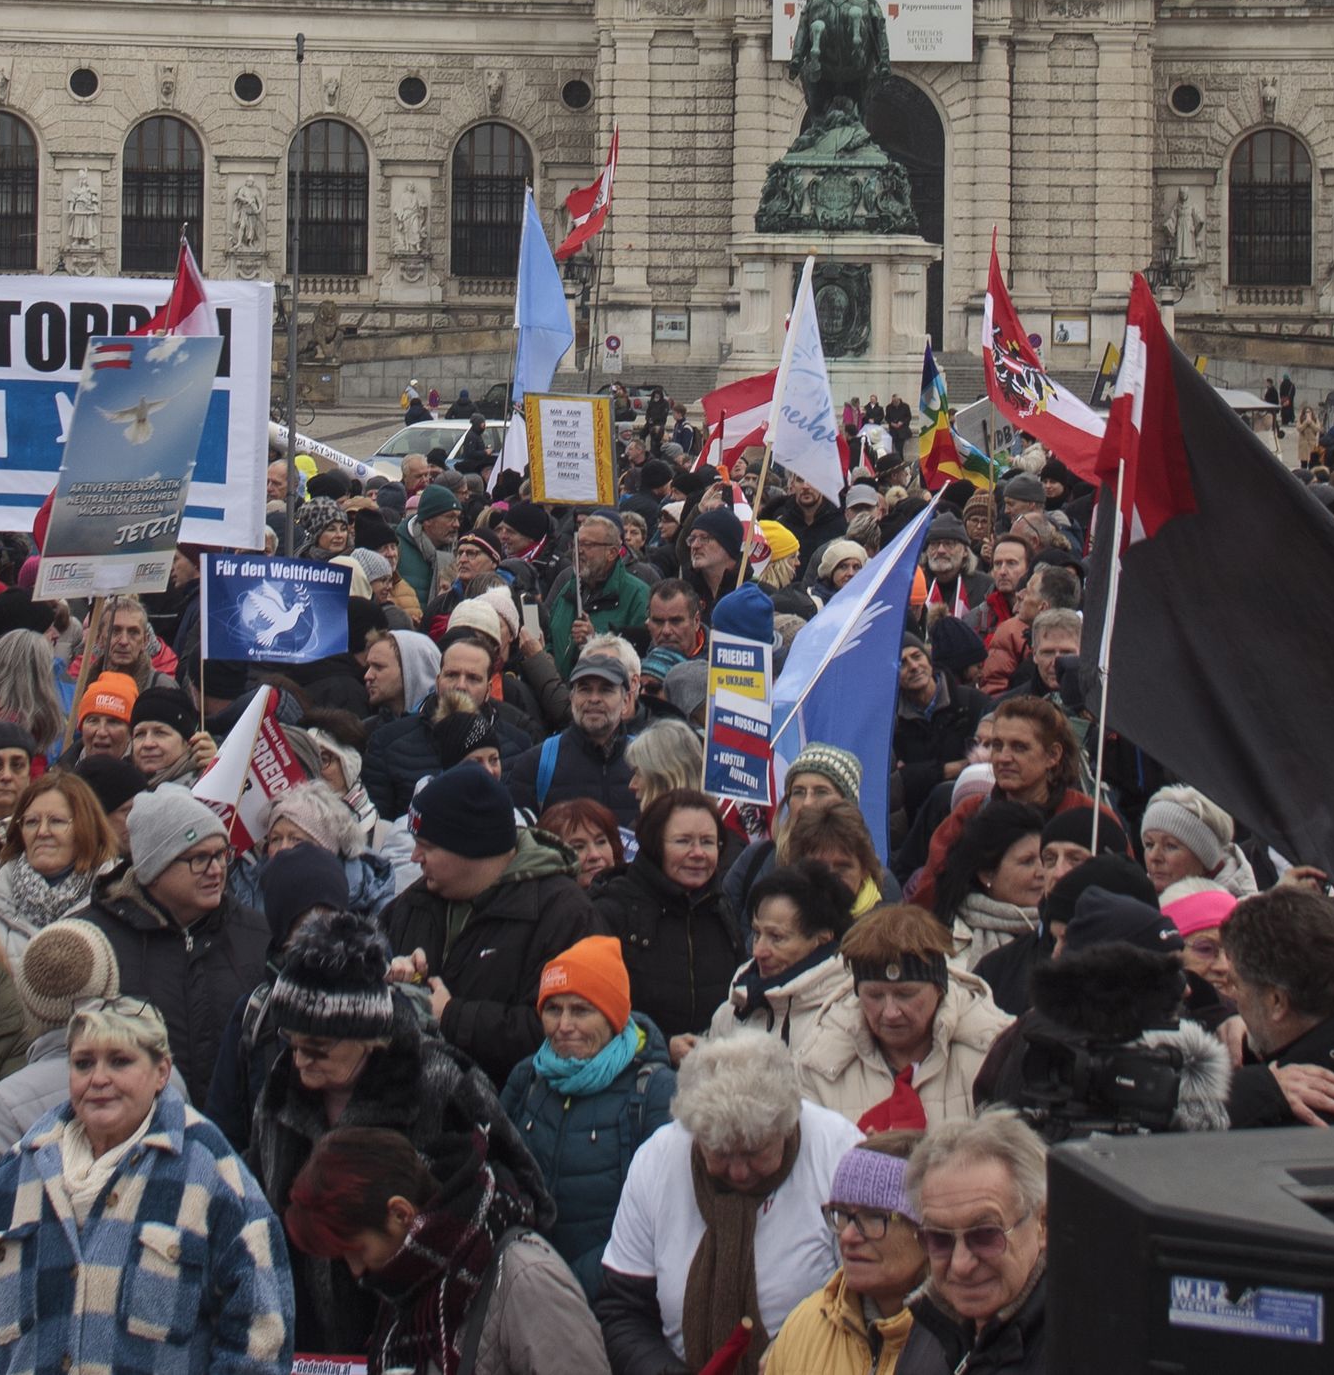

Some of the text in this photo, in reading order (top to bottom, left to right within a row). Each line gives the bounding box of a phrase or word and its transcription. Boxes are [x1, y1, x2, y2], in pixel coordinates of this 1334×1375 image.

[901, 3, 962, 12] Papyrusmuseum
[309, 442, 354, 467] SKYSHIELD
[69, 479, 181, 493] AKTIVE FRIEDENSPOLITIK
[131, 492, 179, 503] BEWAHREN
[77, 504, 165, 517] MIGRATION REGELN
[113, 512, 181, 546] JETZT!
[51, 563, 79, 578] MFG
[216, 560, 345, 585] Für den Weltfrieden
[717, 648, 755, 667] FRIEDEN
[734, 715, 768, 738] RUSSLAND
[719, 752, 746, 768] KOSTEN
[729, 766, 759, 789] RUNTER!
